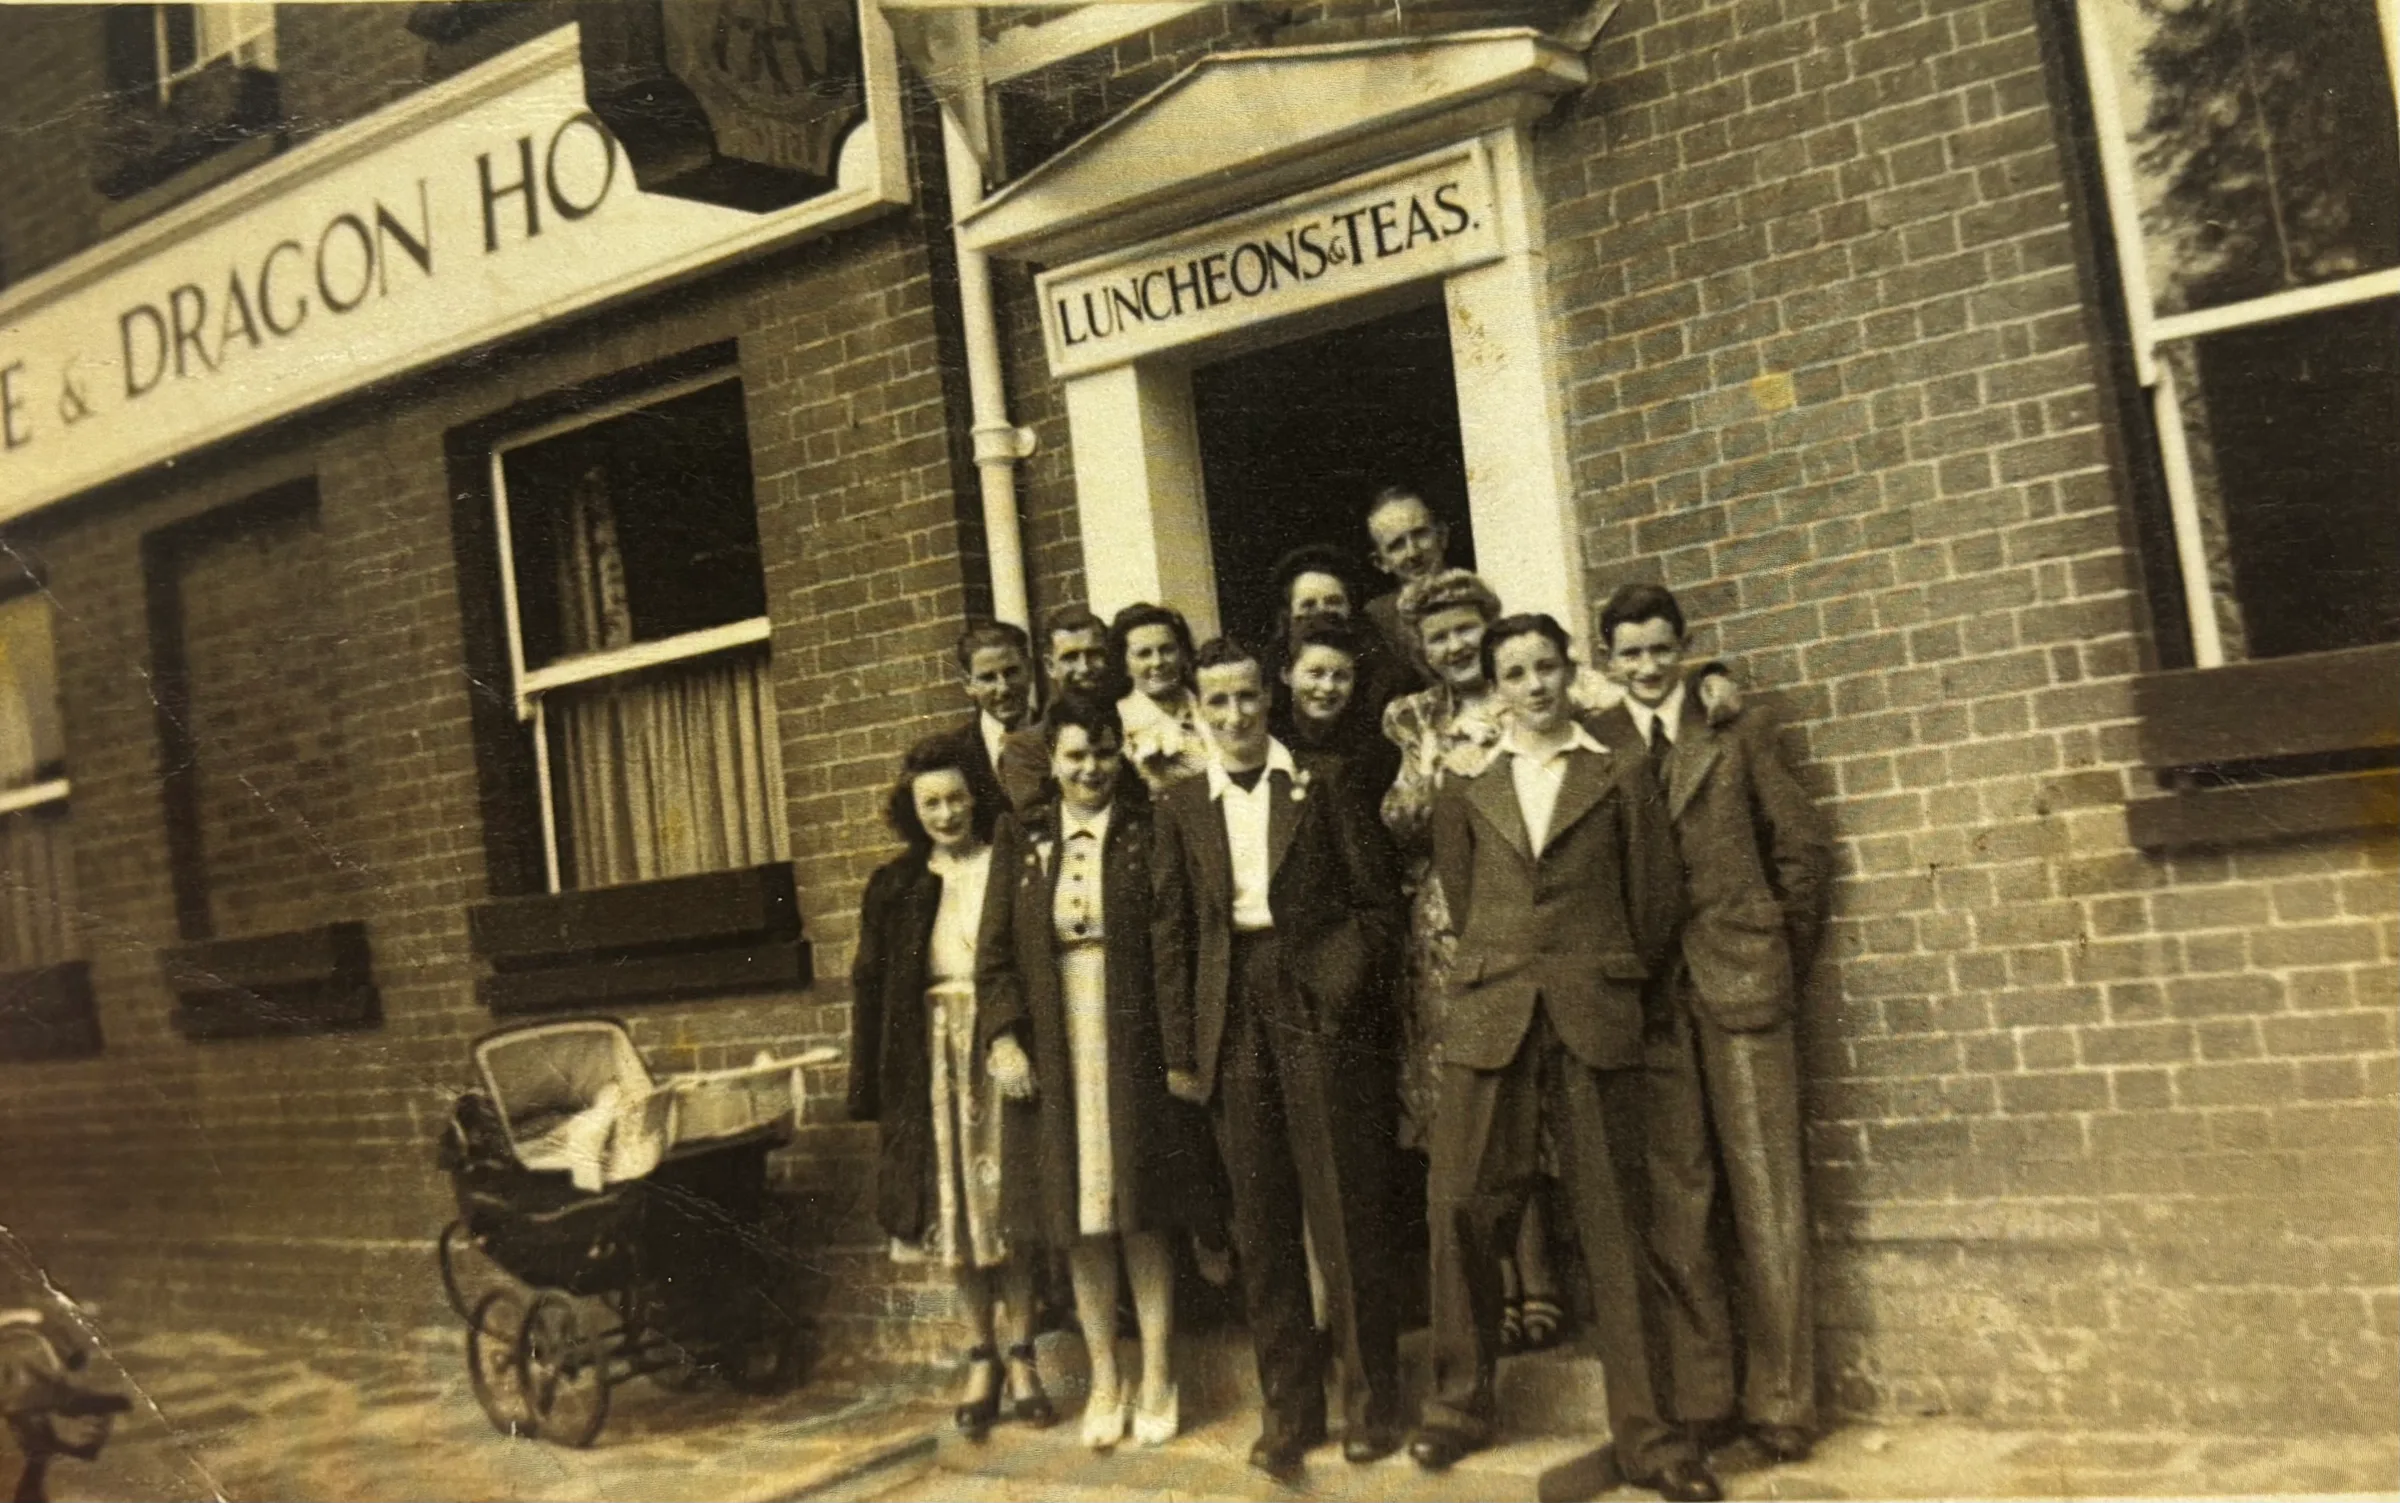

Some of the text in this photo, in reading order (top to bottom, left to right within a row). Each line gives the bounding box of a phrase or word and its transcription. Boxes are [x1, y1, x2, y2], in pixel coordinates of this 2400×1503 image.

[57, 352, 97, 426] &
[118, 178, 433, 399] DRAGON
[1058, 222, 1328, 348] LUNCHEONS
[1332, 183, 1481, 266] TEAS.
